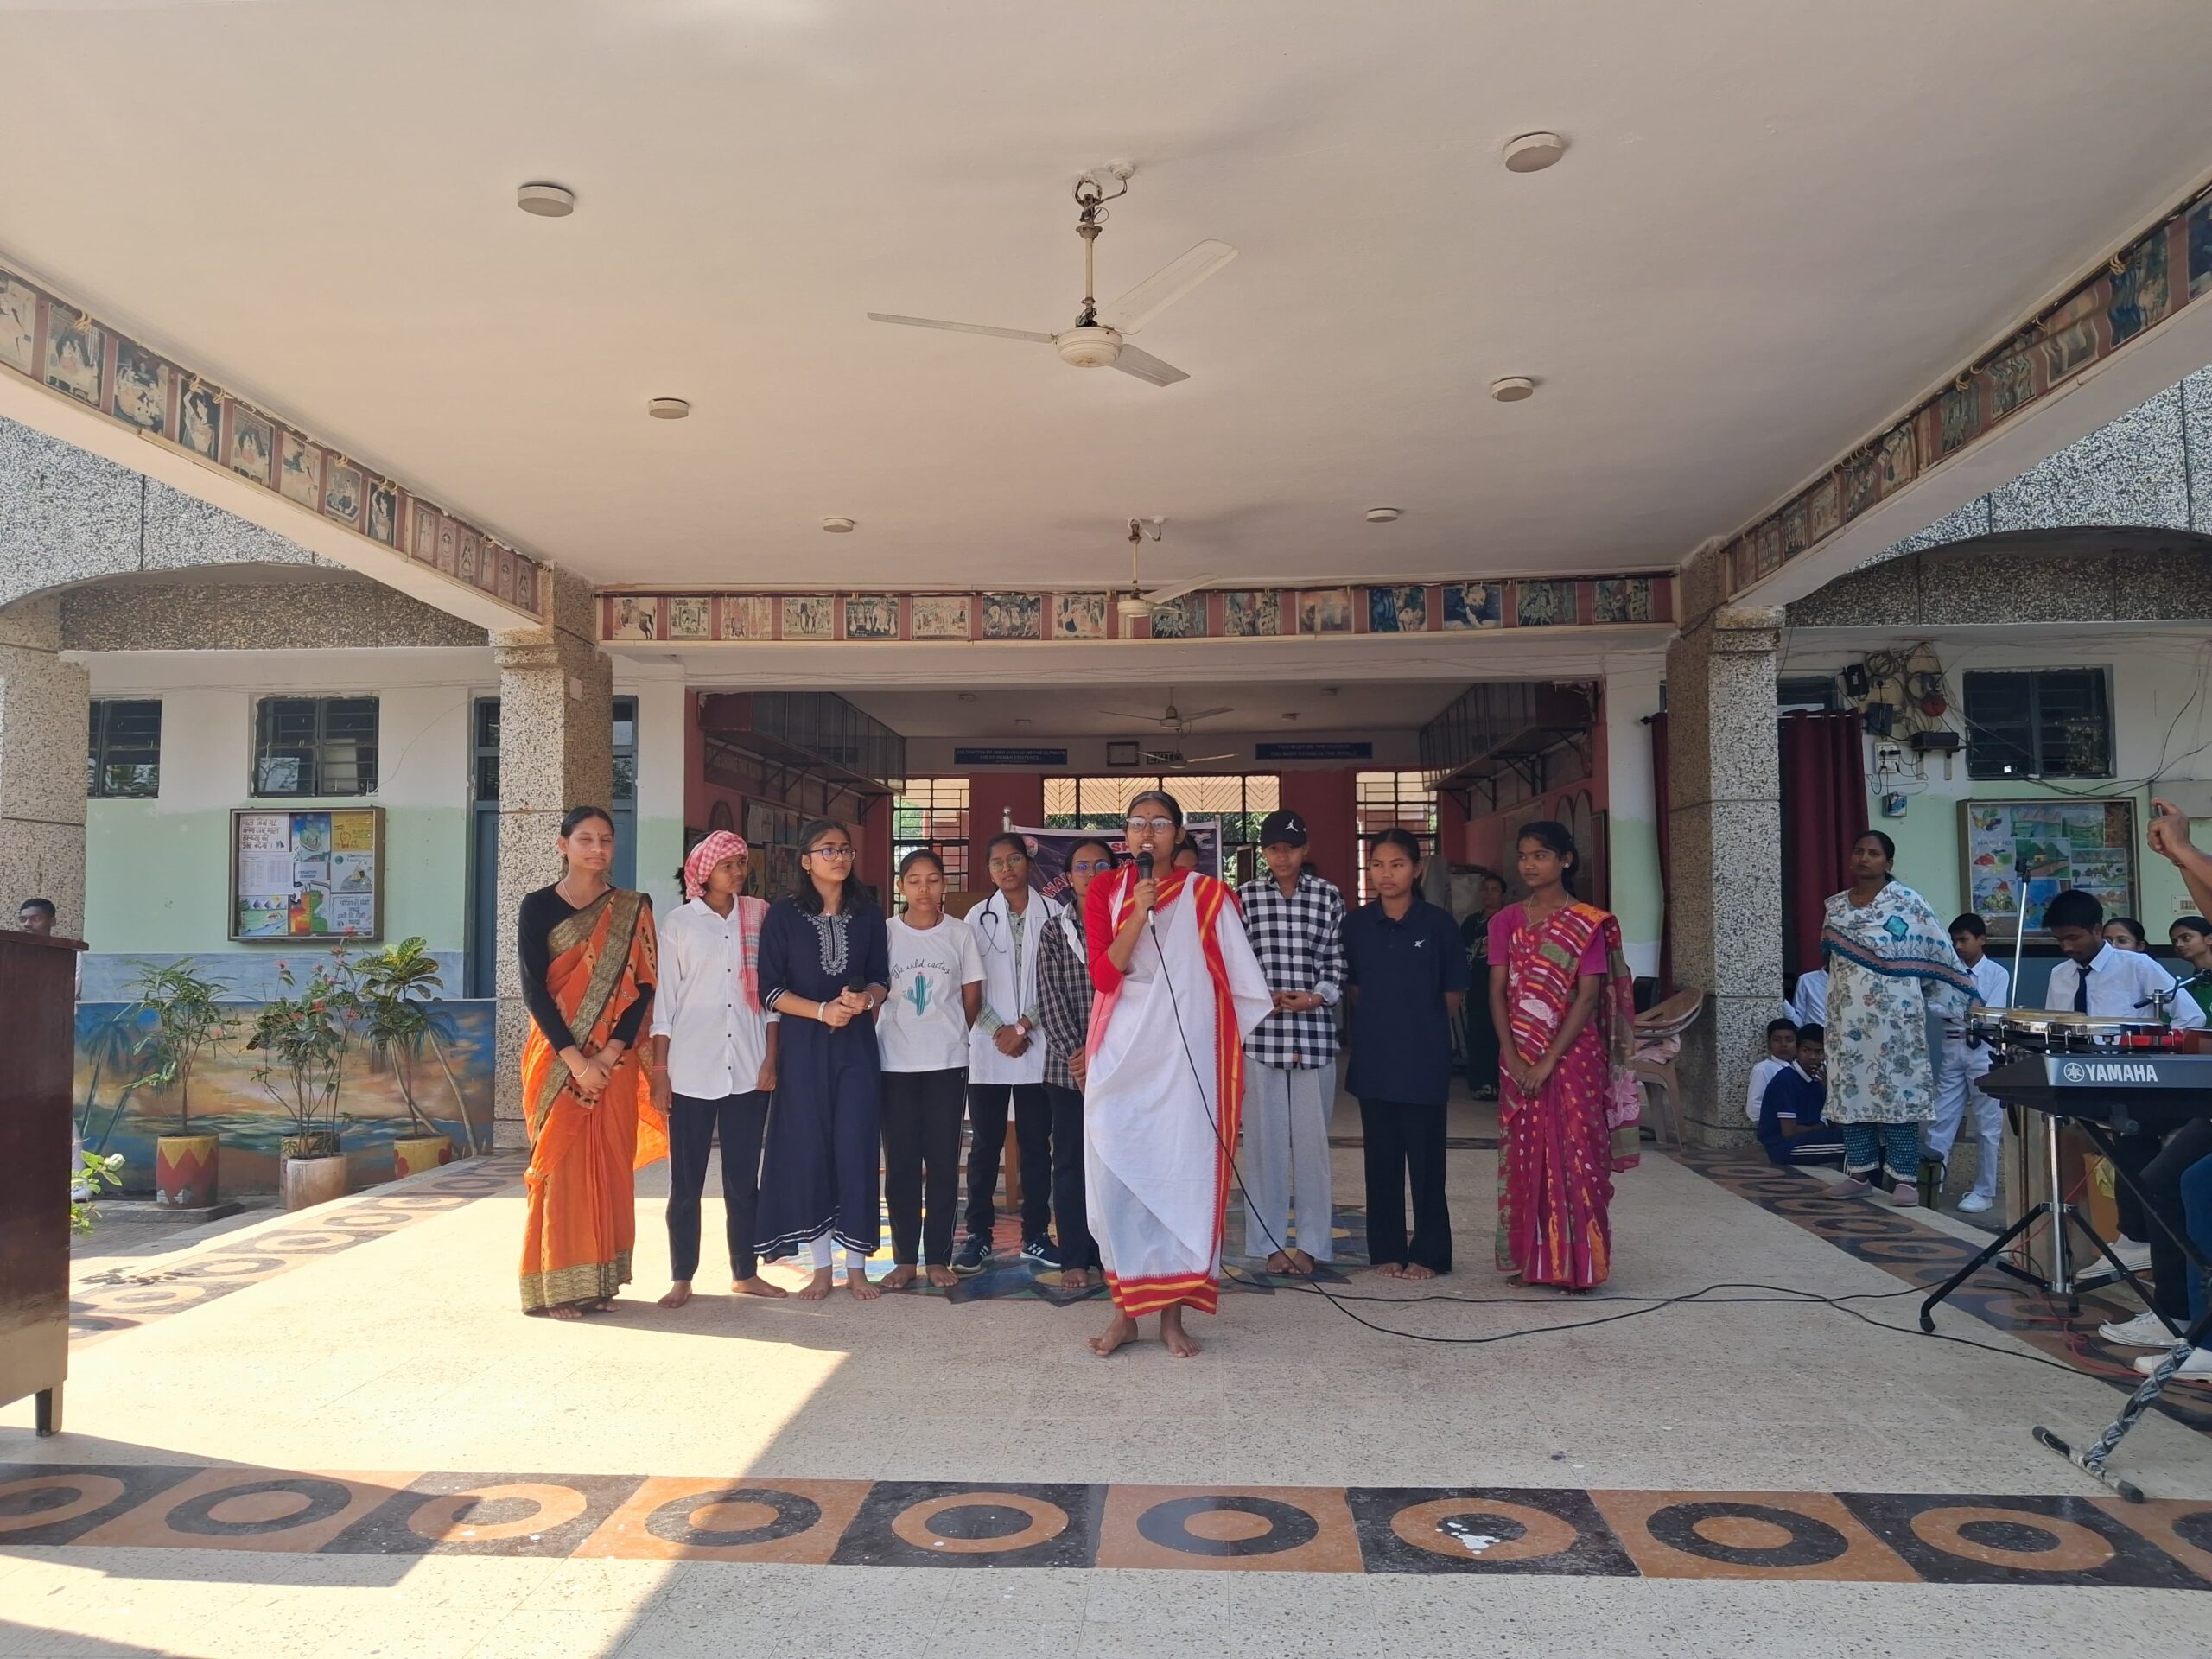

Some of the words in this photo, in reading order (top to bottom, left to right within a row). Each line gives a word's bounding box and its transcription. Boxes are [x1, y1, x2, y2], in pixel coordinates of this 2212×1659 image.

[891, 963, 904, 979] The
[906, 959, 925, 970] wild
[927, 960, 950, 975] cactus
[2085, 1065, 2158, 1081] YAMAHA
